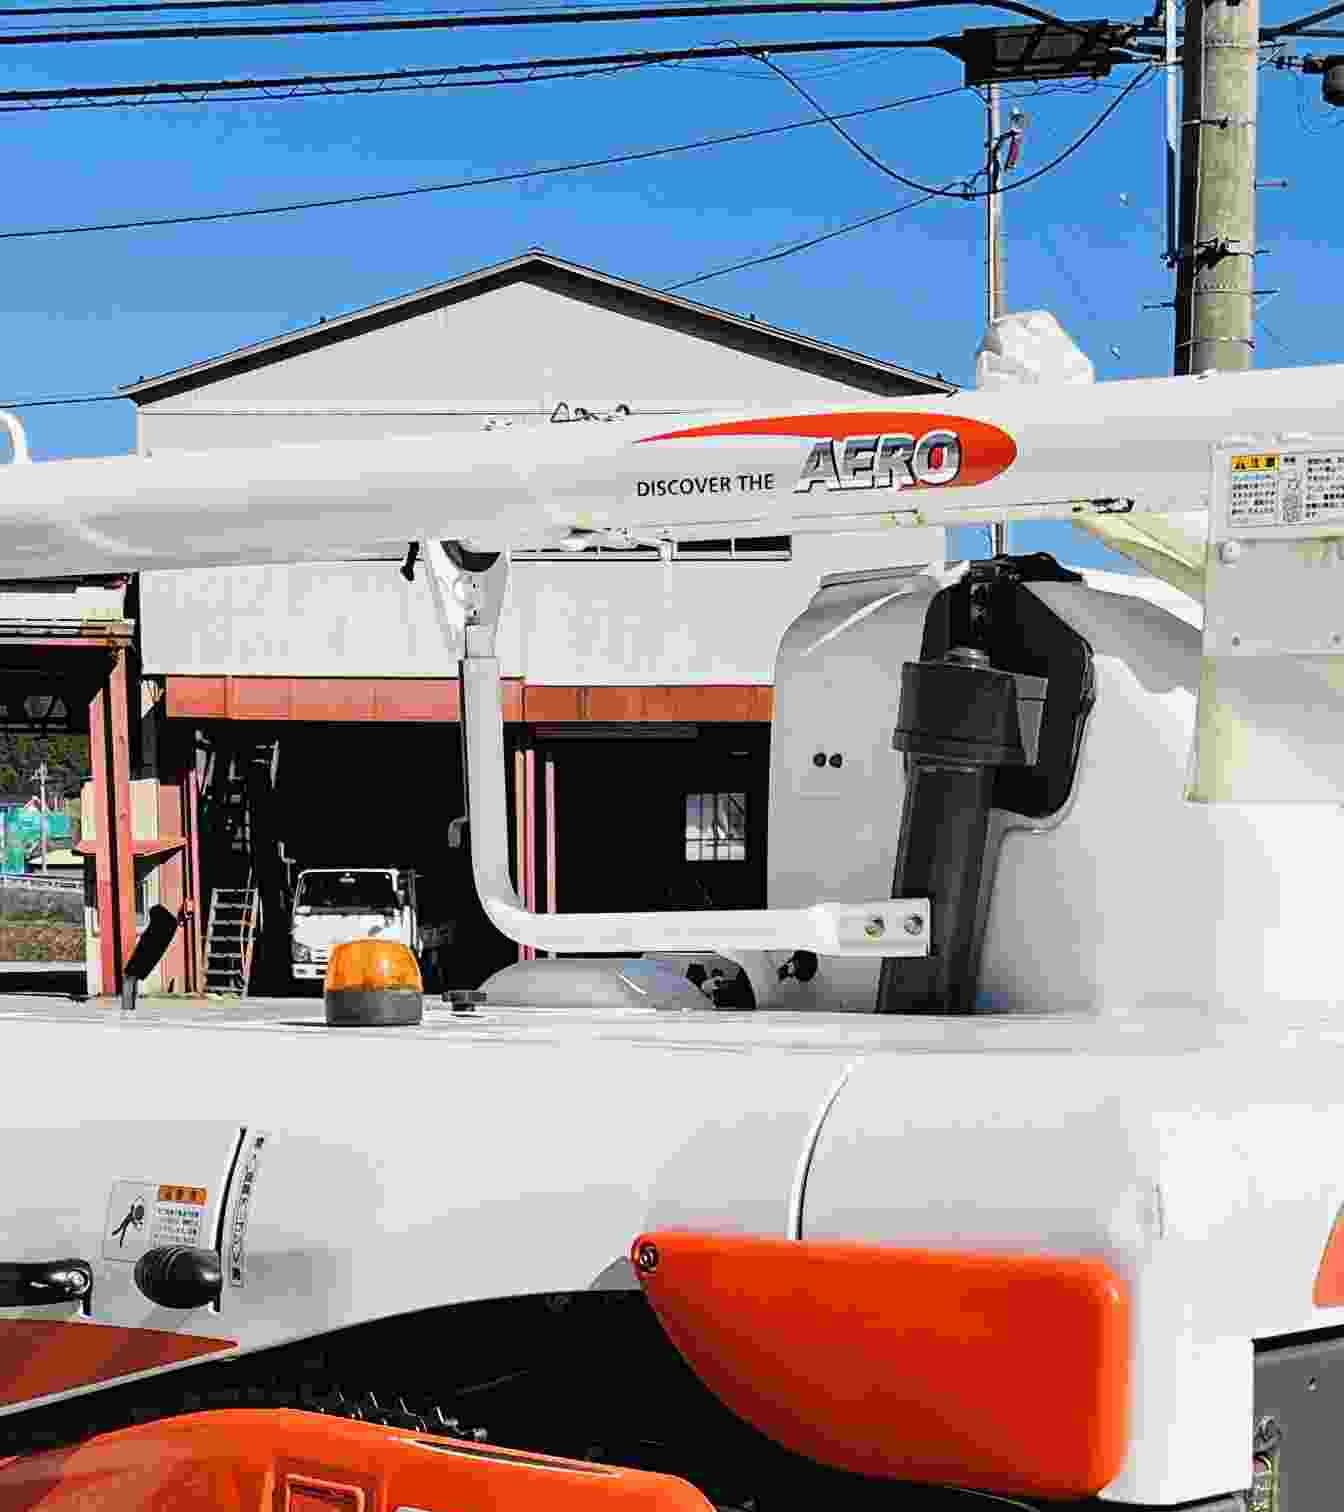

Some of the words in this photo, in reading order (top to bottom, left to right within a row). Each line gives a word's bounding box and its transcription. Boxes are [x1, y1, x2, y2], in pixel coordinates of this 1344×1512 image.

[636, 475, 731, 497] DISCOVER
[734, 472, 775, 492] THE
[791, 430, 962, 495] AERO
